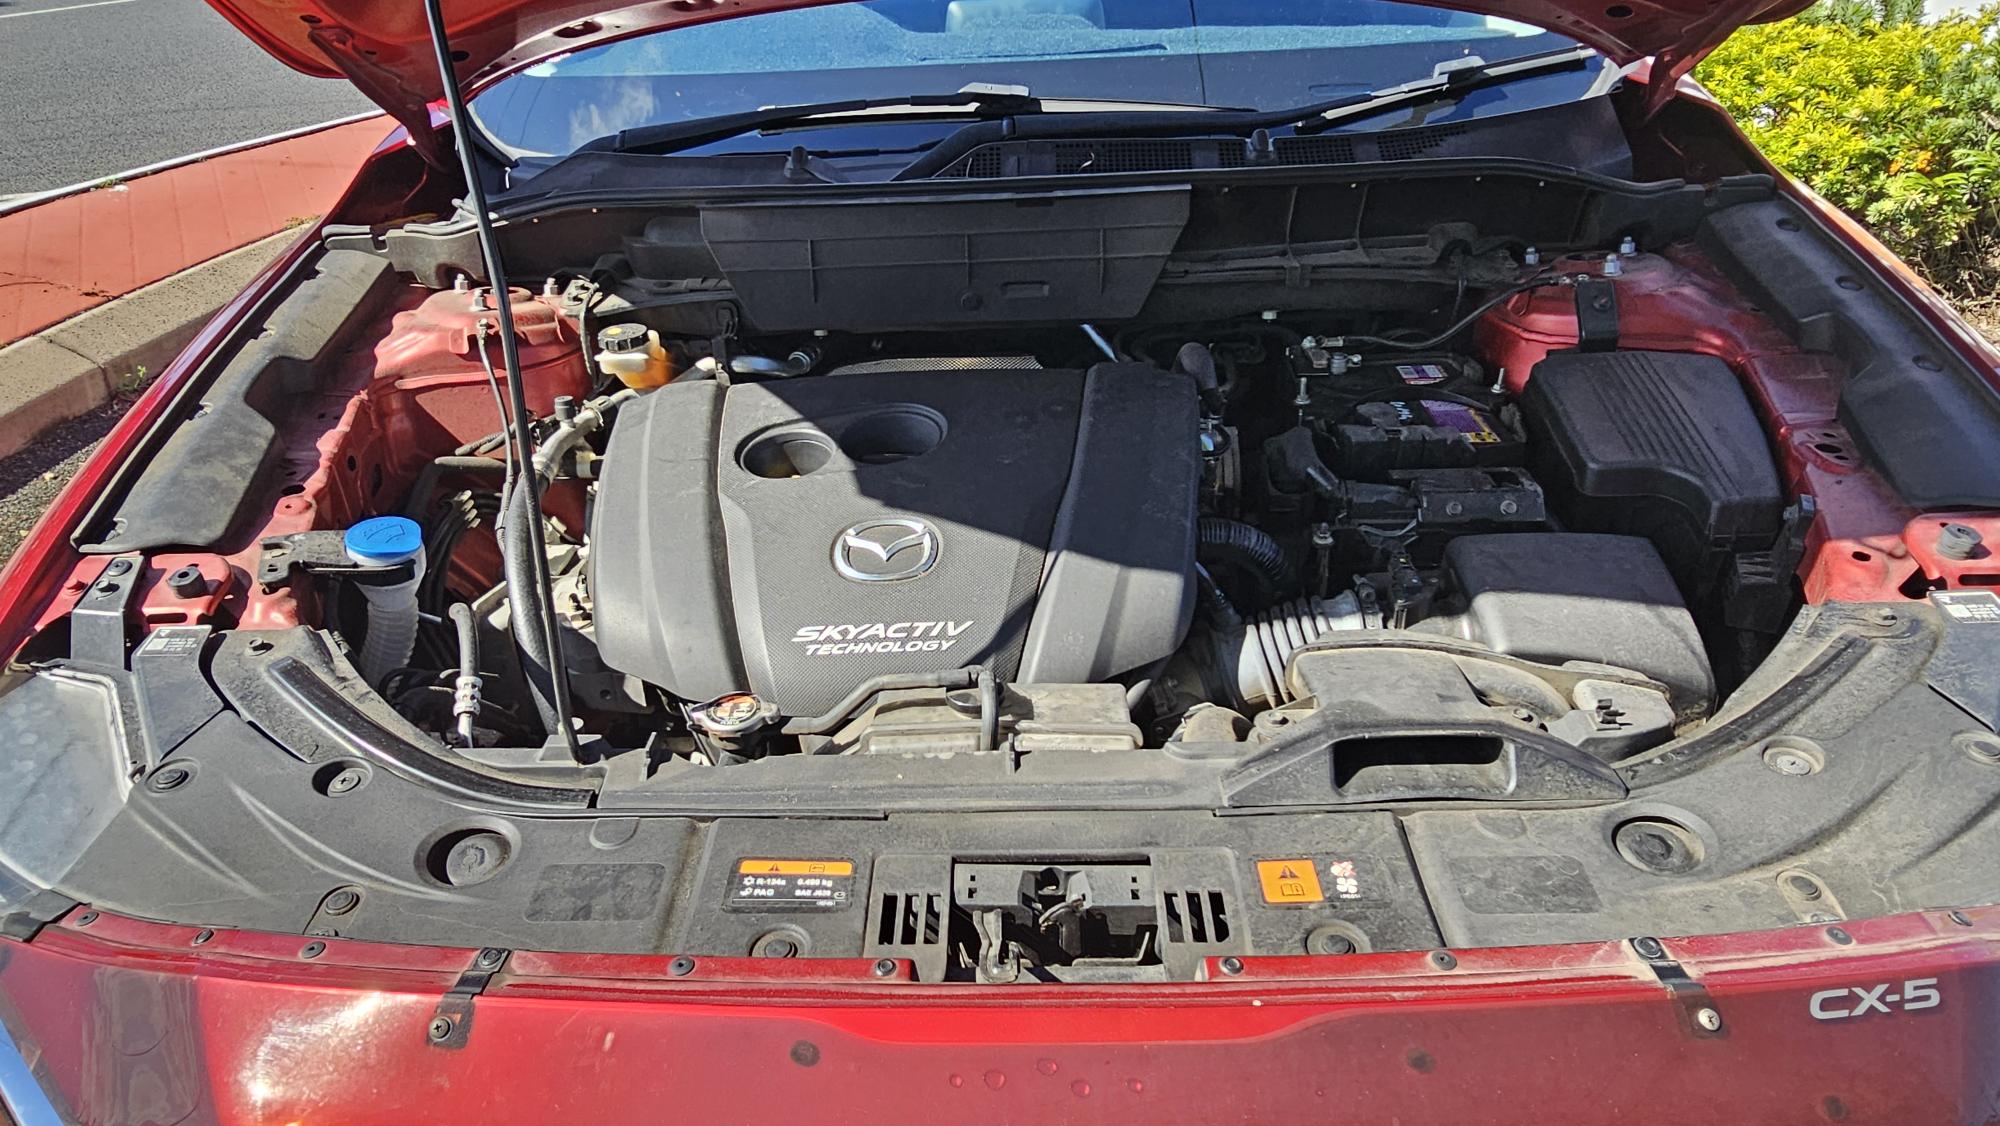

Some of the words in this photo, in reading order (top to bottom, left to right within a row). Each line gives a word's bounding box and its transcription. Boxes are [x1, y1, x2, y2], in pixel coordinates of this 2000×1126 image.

[791, 620, 975, 642] SKYACTIV
[805, 639, 958, 656] TECHNOLOGY
[1809, 977, 1941, 1020] CX-5
